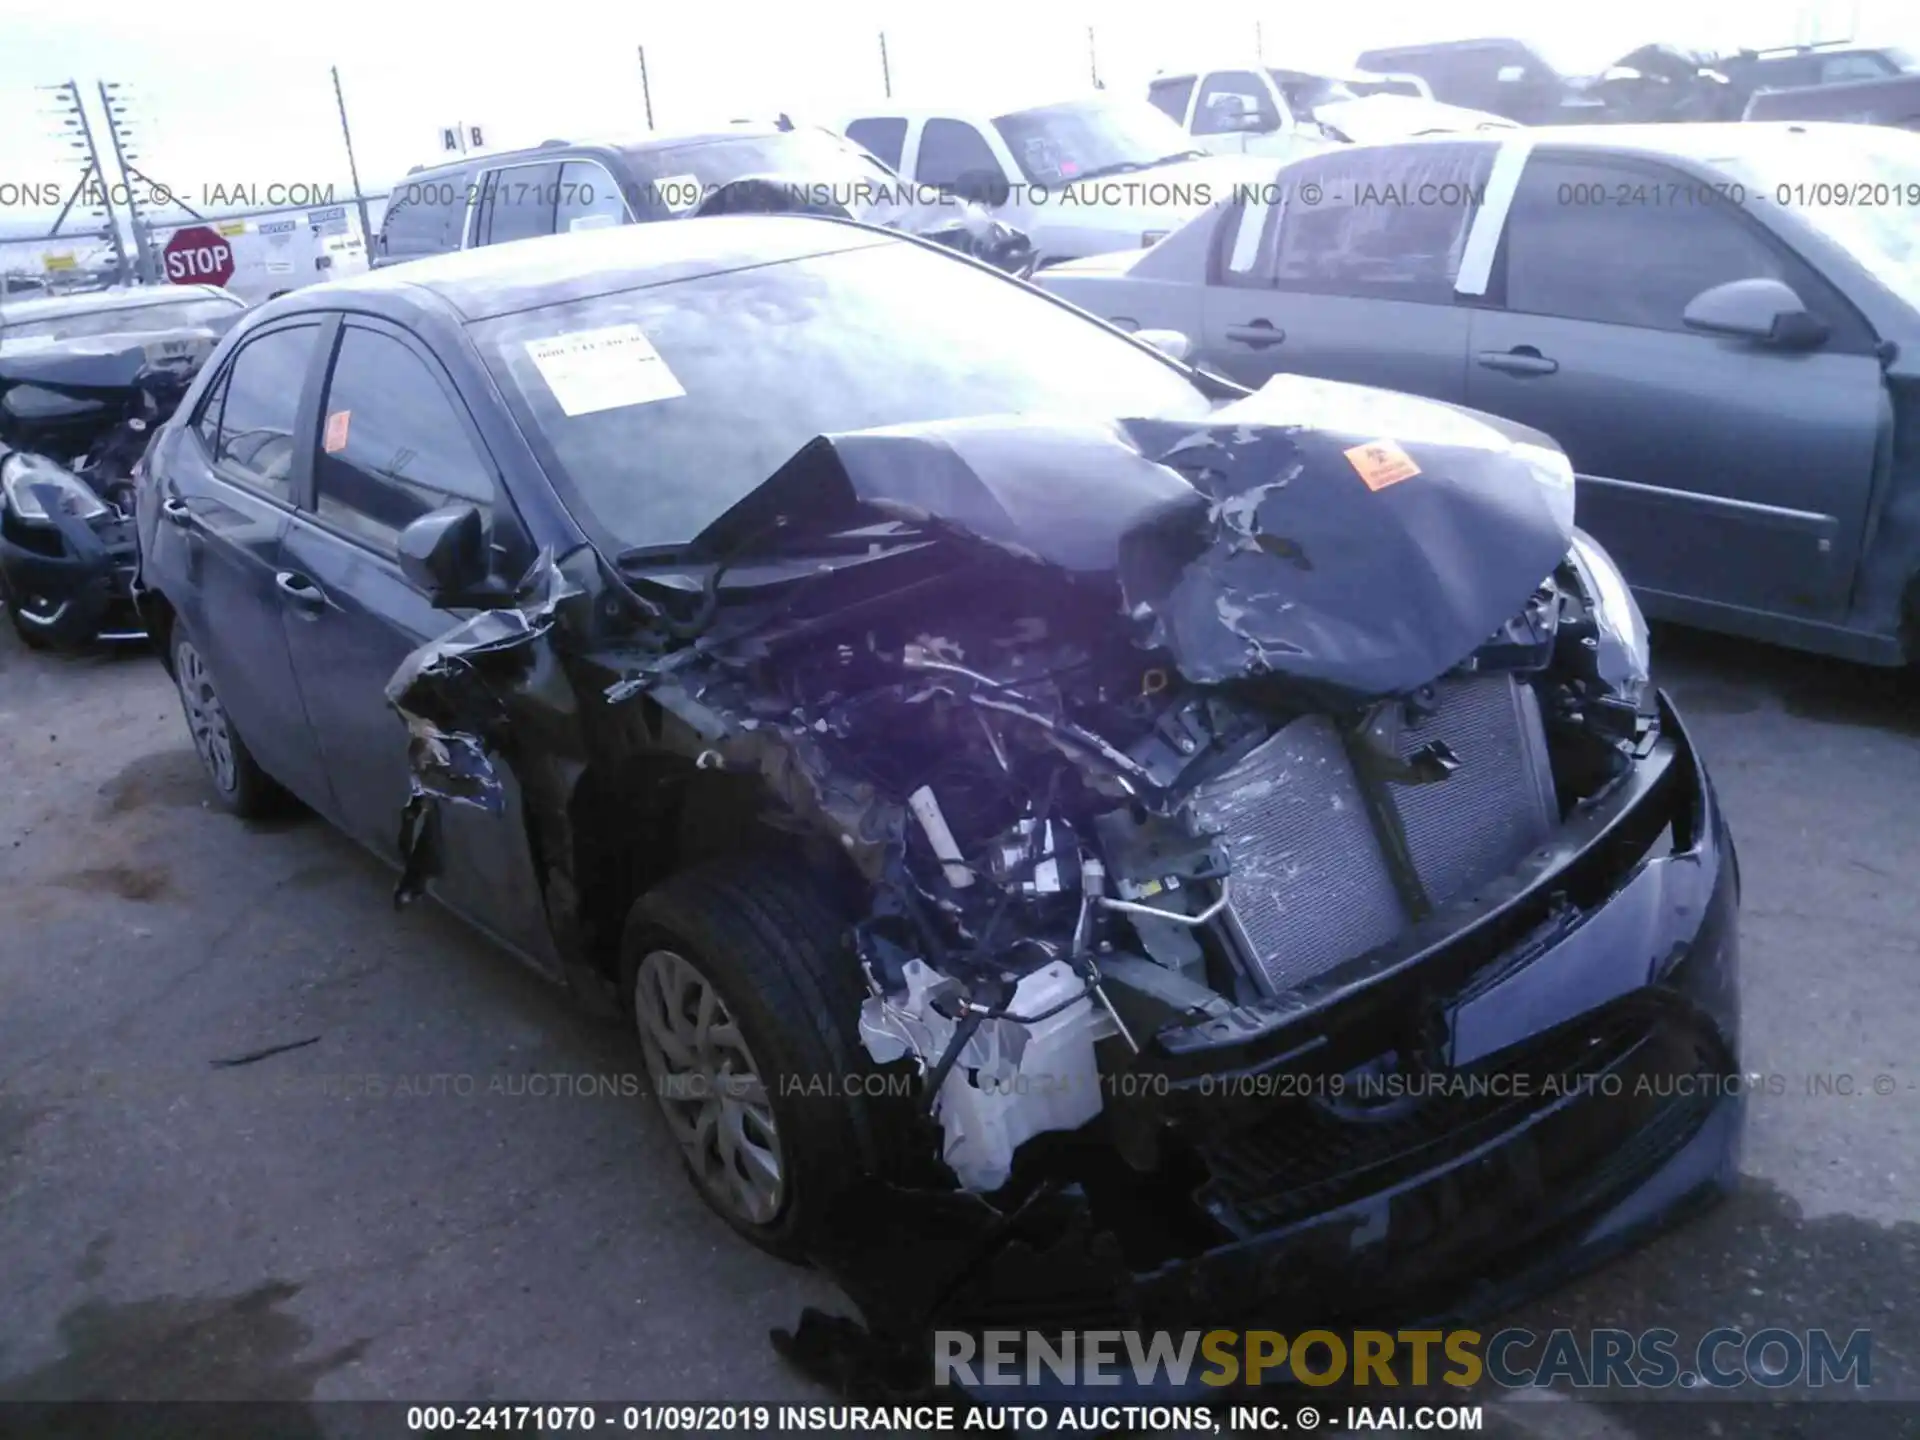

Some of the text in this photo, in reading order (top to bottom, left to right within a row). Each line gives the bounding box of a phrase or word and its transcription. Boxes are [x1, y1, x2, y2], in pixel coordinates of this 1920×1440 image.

[445, 129, 457, 150] A
[471, 126, 483, 146] B
[168, 245, 228, 278] STOP
